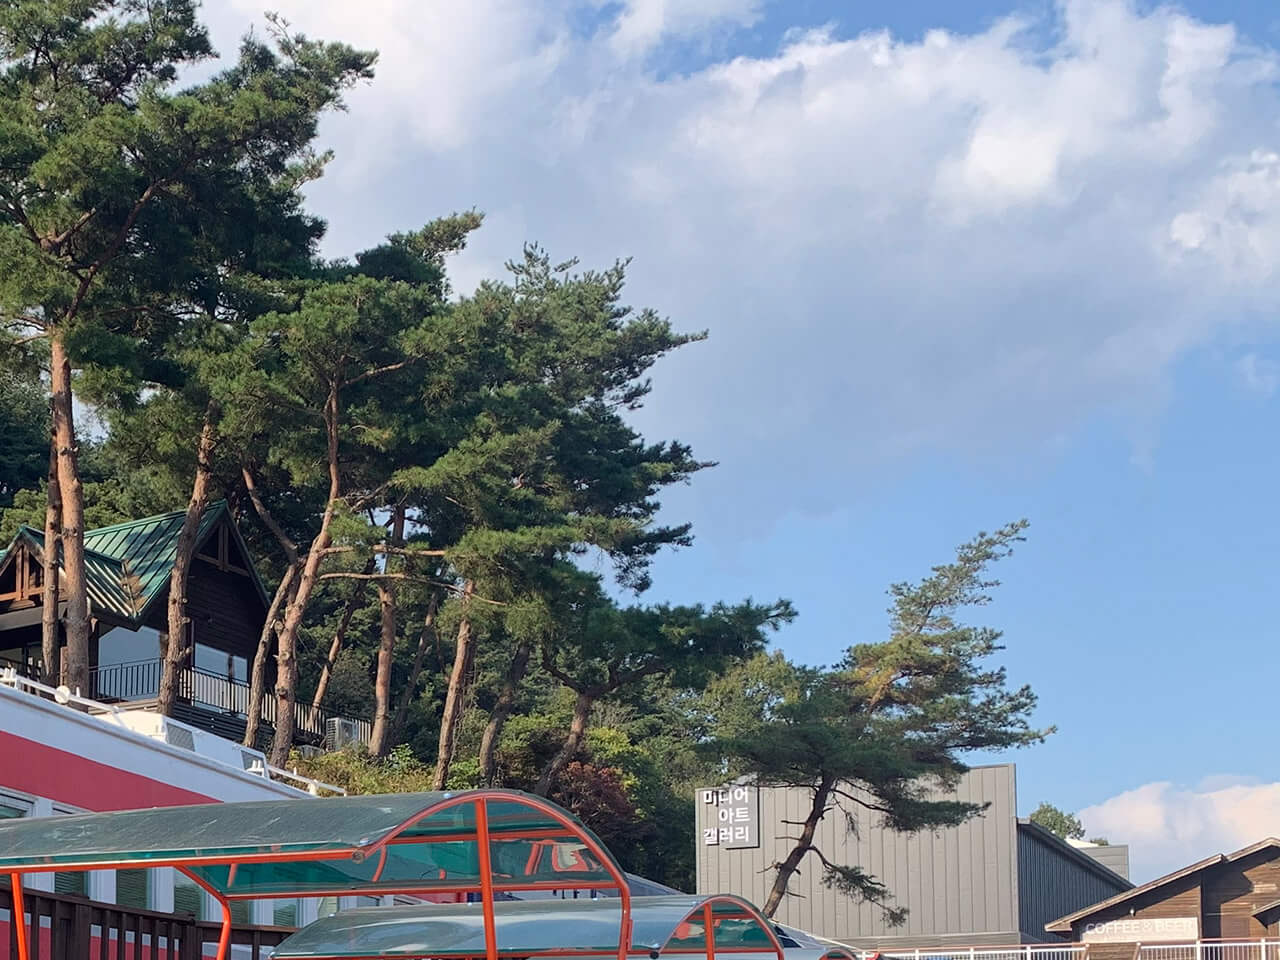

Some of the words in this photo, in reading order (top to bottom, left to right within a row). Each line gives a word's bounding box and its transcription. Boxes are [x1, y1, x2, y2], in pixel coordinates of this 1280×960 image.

[704, 787, 749, 806] 미디어
[719, 807, 751, 824] 아트
[704, 826, 749, 845] 갤러리
[1085, 921, 1141, 934] COFFEE
[1154, 919, 1195, 932] BEER
